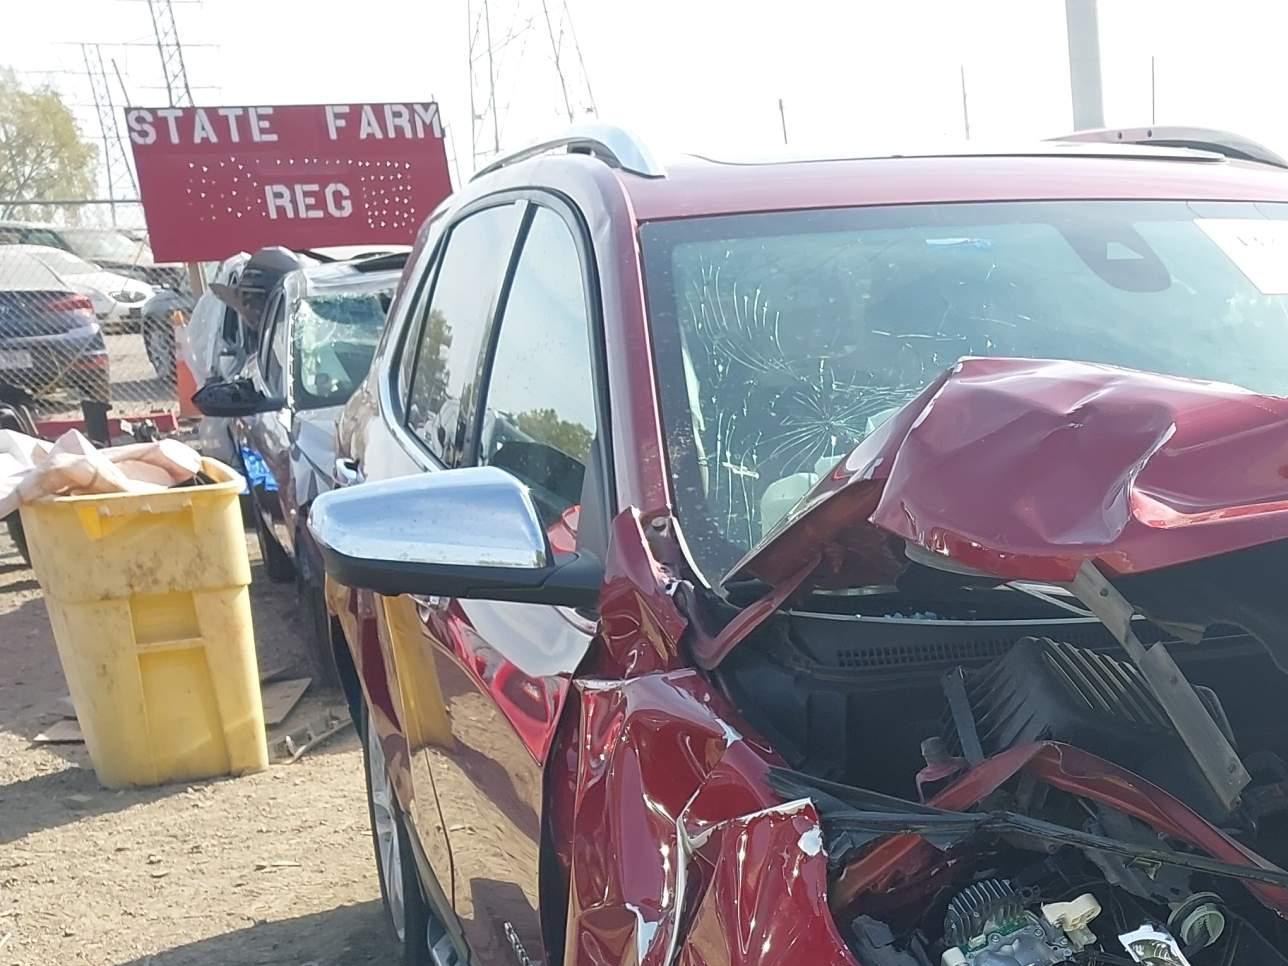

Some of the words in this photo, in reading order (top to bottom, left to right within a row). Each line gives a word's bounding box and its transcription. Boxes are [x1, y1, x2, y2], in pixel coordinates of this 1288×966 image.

[127, 106, 278, 145] STATE
[325, 104, 443, 140] FARM
[264, 183, 352, 219] REG
